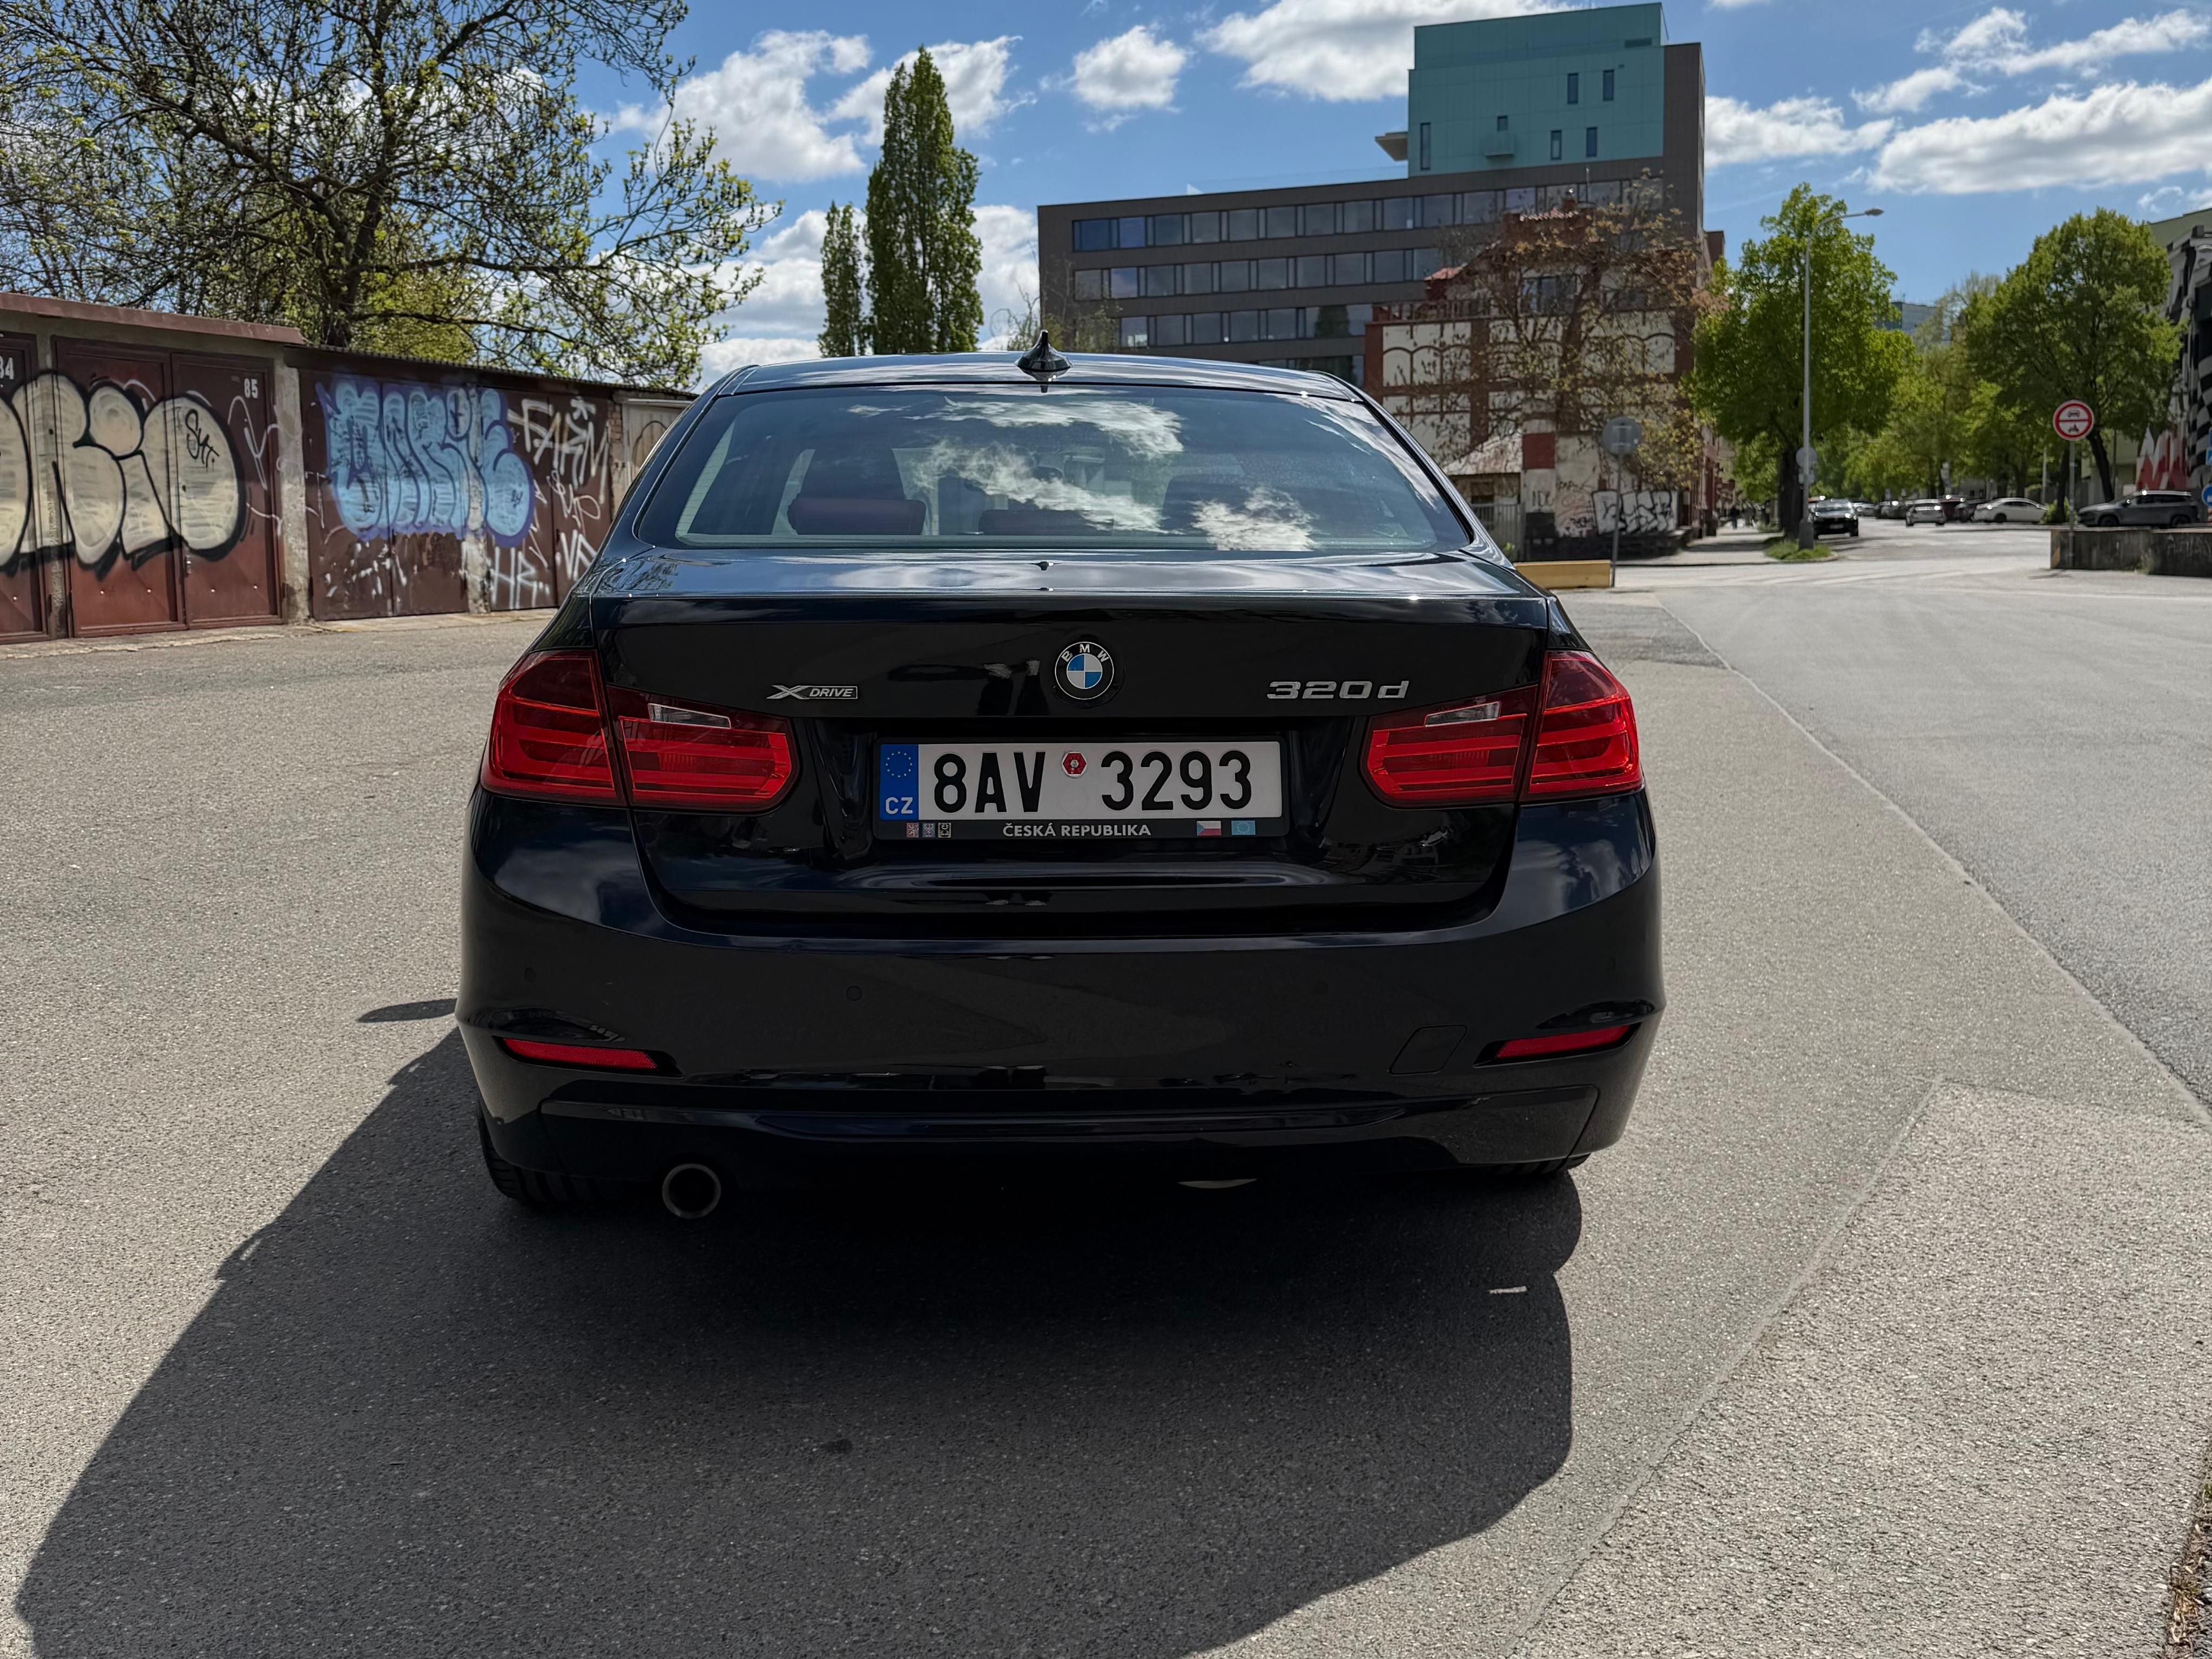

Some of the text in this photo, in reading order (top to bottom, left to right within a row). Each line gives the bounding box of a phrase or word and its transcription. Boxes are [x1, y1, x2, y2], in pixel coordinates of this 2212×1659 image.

[244, 378, 258, 399] 85
[1061, 643, 1109, 662] BMW
[1267, 680, 1410, 699] 320d
[934, 750, 1252, 813] 8AV 3293
[885, 797, 913, 814] CZ
[1003, 822, 1151, 837] ČESKÁ REPUBLIKA
